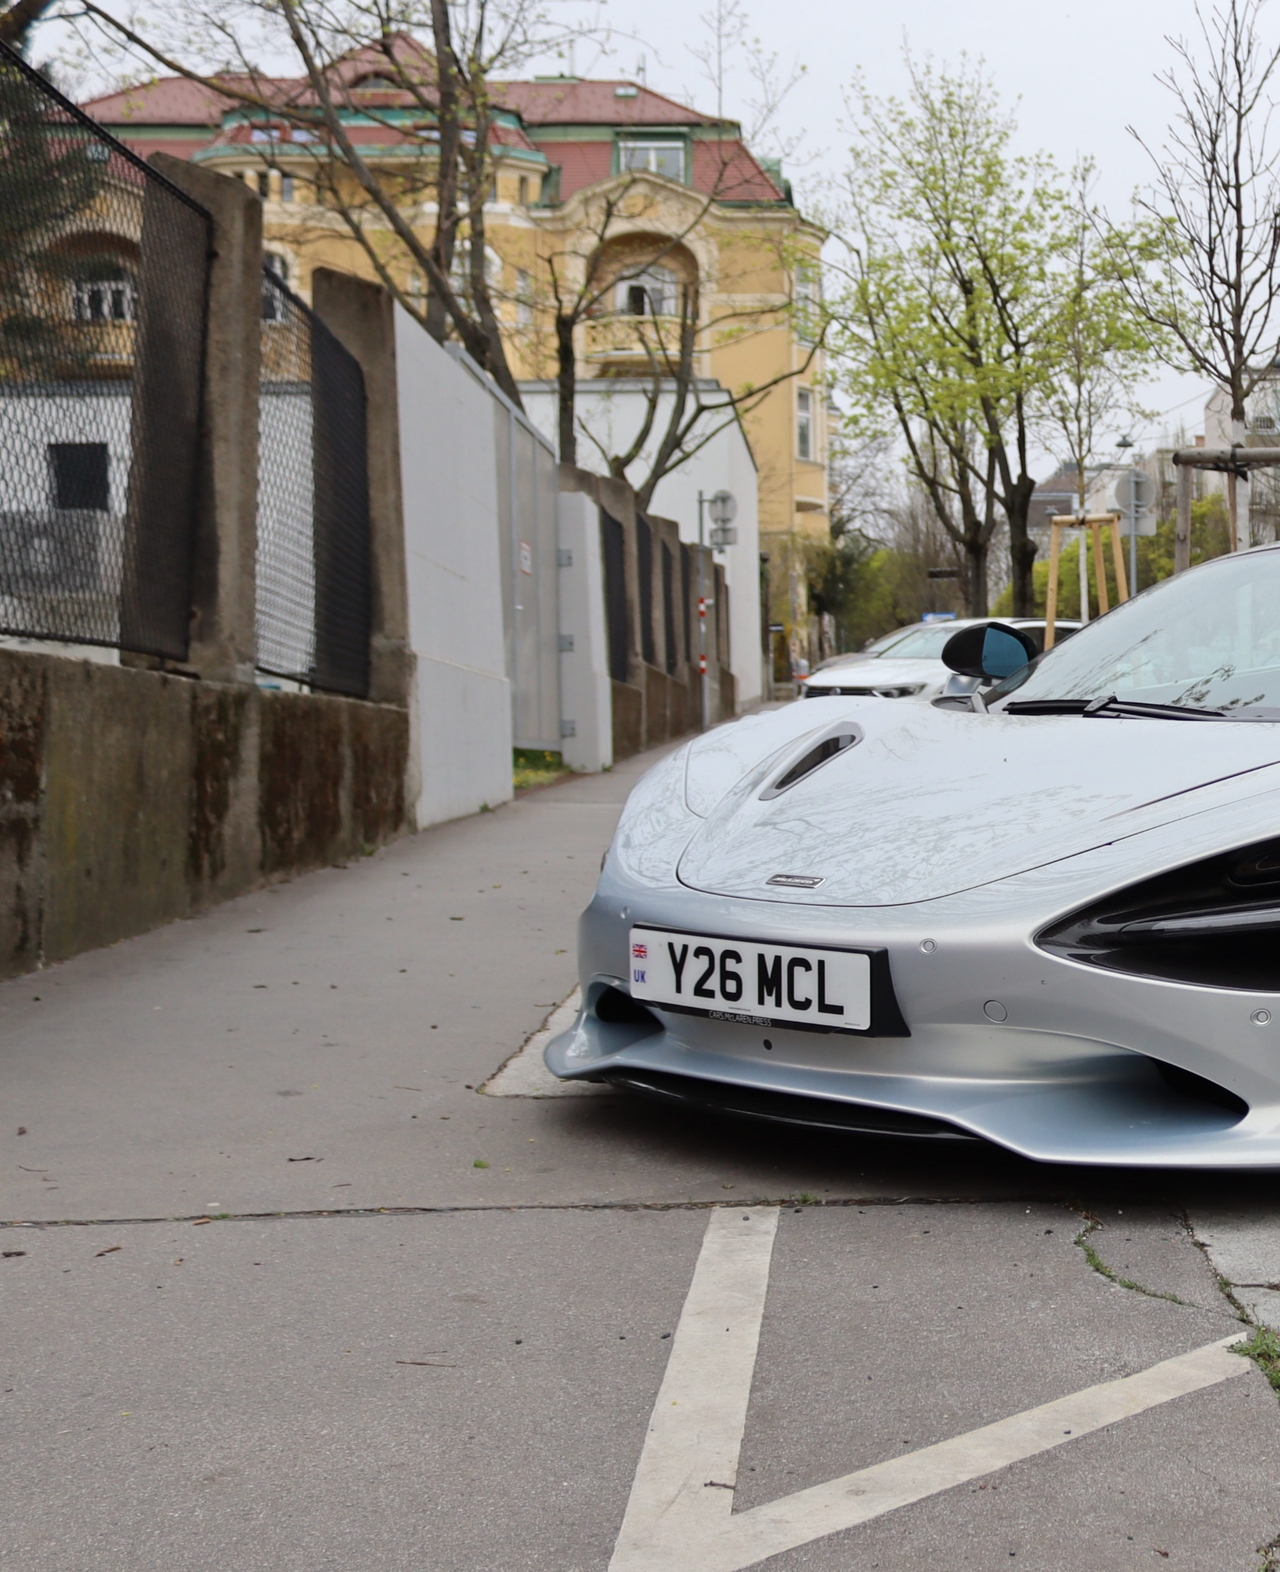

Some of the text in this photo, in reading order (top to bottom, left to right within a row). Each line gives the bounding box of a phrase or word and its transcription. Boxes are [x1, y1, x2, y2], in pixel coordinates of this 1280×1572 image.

[633, 969, 647, 984] UK
[667, 941, 845, 1016] Y26 MCL
